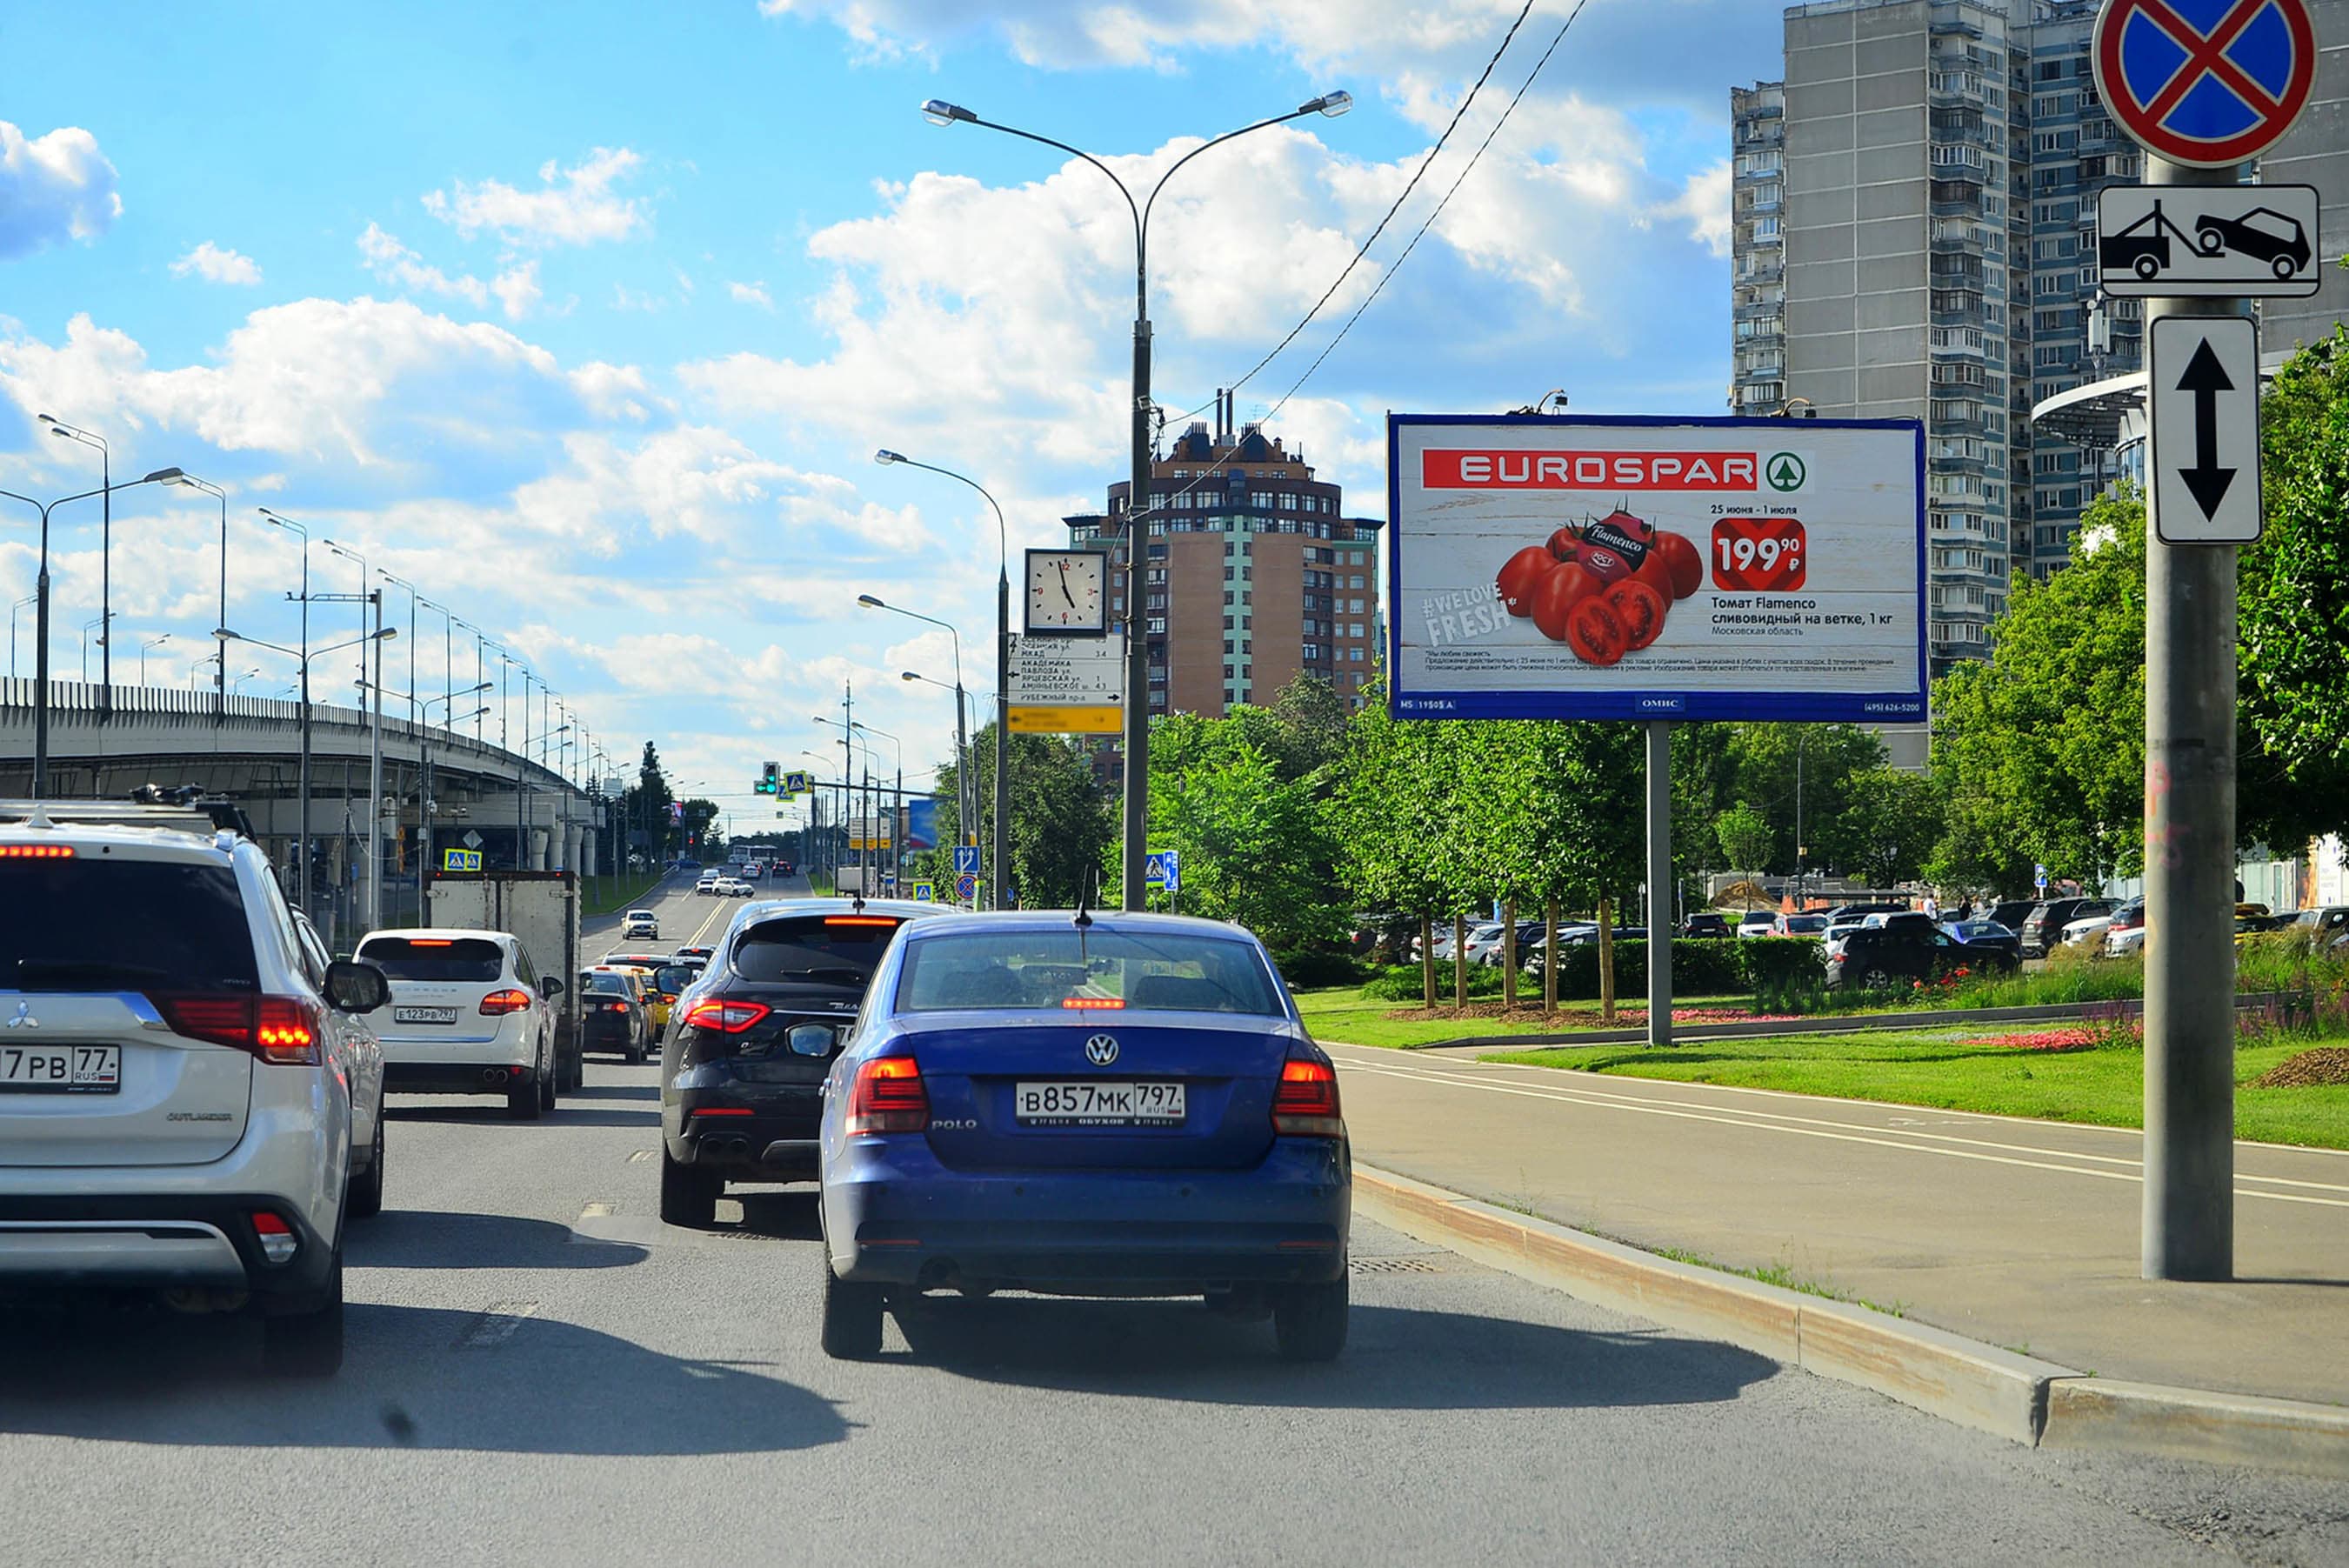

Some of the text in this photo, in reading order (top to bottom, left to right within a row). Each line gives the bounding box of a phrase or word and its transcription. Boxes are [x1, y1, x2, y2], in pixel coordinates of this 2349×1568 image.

[1460, 456, 1754, 484] EUROSPAR
[1711, 504, 1724, 514] 25
[1726, 506, 1753, 515] июня
[1763, 504, 1768, 514] 1
[1771, 506, 1798, 515] июля
[1592, 524, 1642, 552] Flamenco
[1717, 537, 1799, 571] 199 90
[1422, 581, 1502, 618] #WE LOVE
[1712, 597, 1816, 609] Томат Flamenco
[1712, 613, 1892, 626] сливовидный на ветке, 1 кг
[1711, 627, 1804, 636] Московская область
[1021, 650, 1044, 658] МКАД
[398, 1009, 437, 1019] Е123РВ
[0, 1049, 108, 1078] 7РВ 77
[75, 1071, 98, 1080] RUS
[1025, 1085, 1178, 1112] В857МК 797
[1146, 1105, 1166, 1114] RUS
[931, 1119, 978, 1130] POLO
